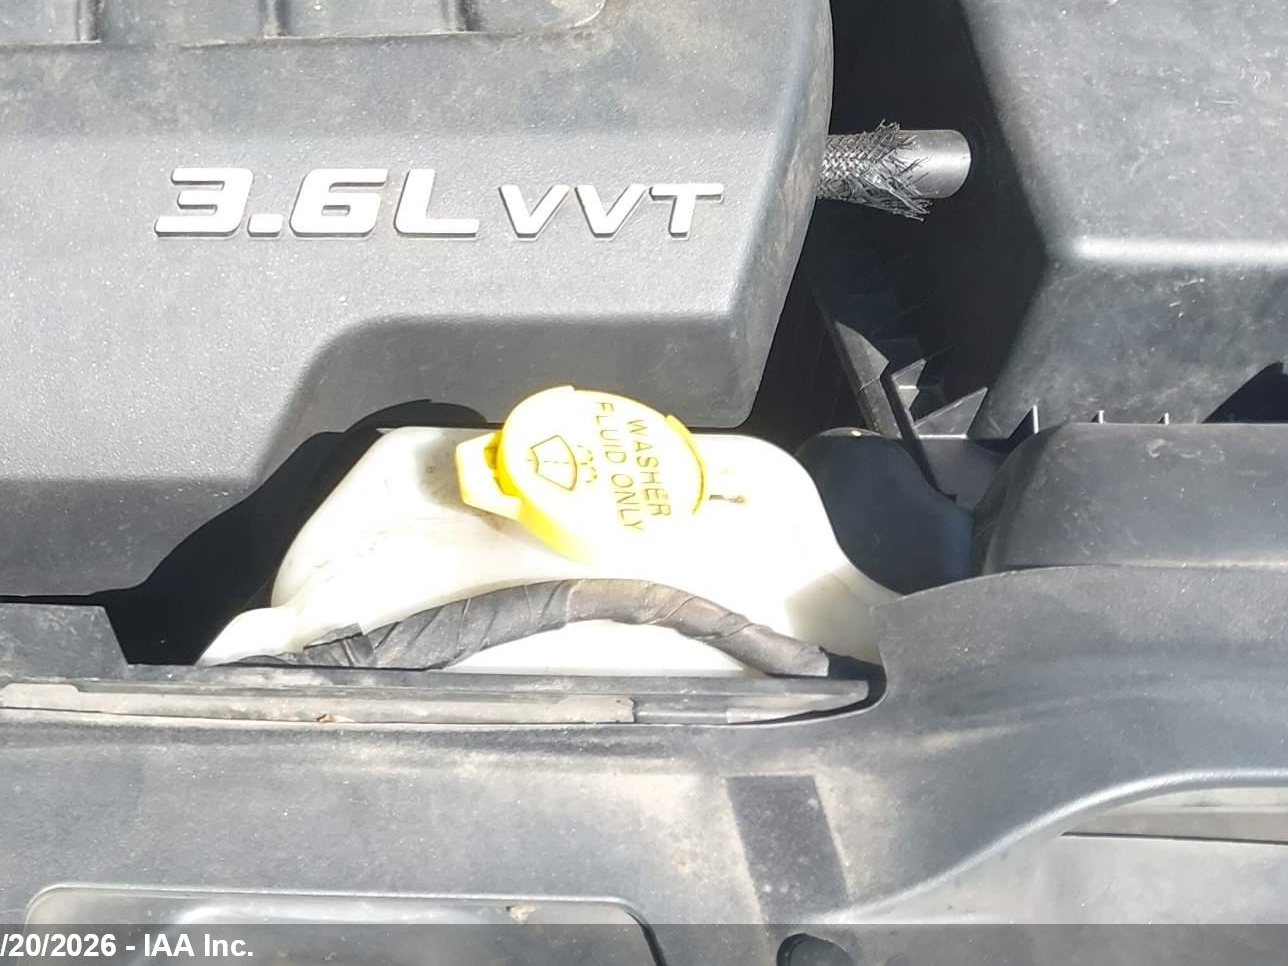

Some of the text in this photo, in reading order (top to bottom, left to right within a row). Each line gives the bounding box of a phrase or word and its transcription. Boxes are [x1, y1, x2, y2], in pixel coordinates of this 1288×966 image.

[154, 167, 725, 241] 3.6L VVT
[594, 402, 644, 532] FLUID ONLY
[628, 419, 672, 517] WASHER
